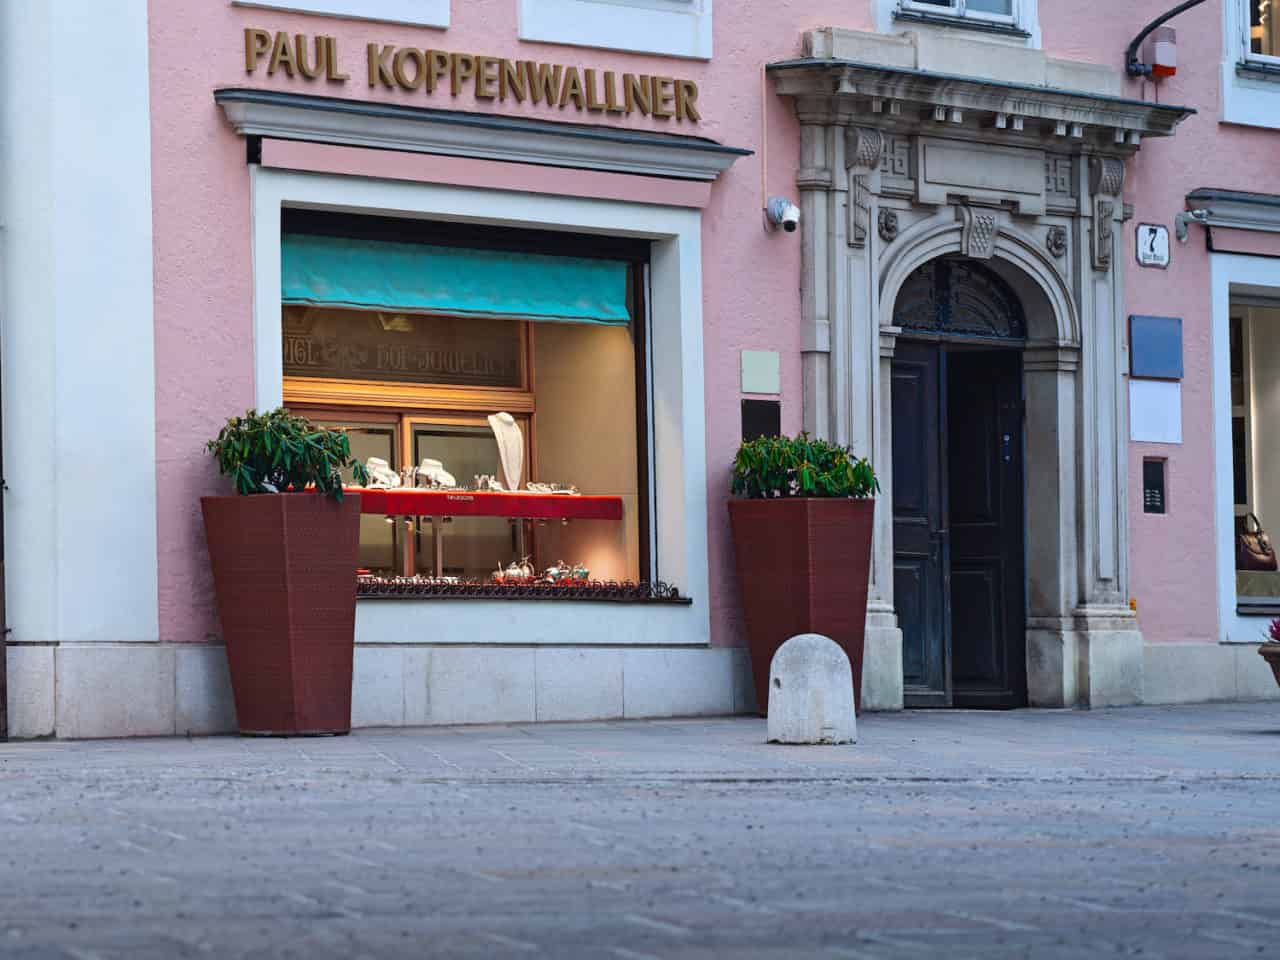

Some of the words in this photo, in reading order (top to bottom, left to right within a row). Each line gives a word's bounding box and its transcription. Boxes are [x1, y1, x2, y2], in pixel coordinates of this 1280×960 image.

[244, 28, 350, 82] PAUL
[367, 42, 701, 122] KOPPENWALLNER
[1148, 227, 1158, 253] 7
